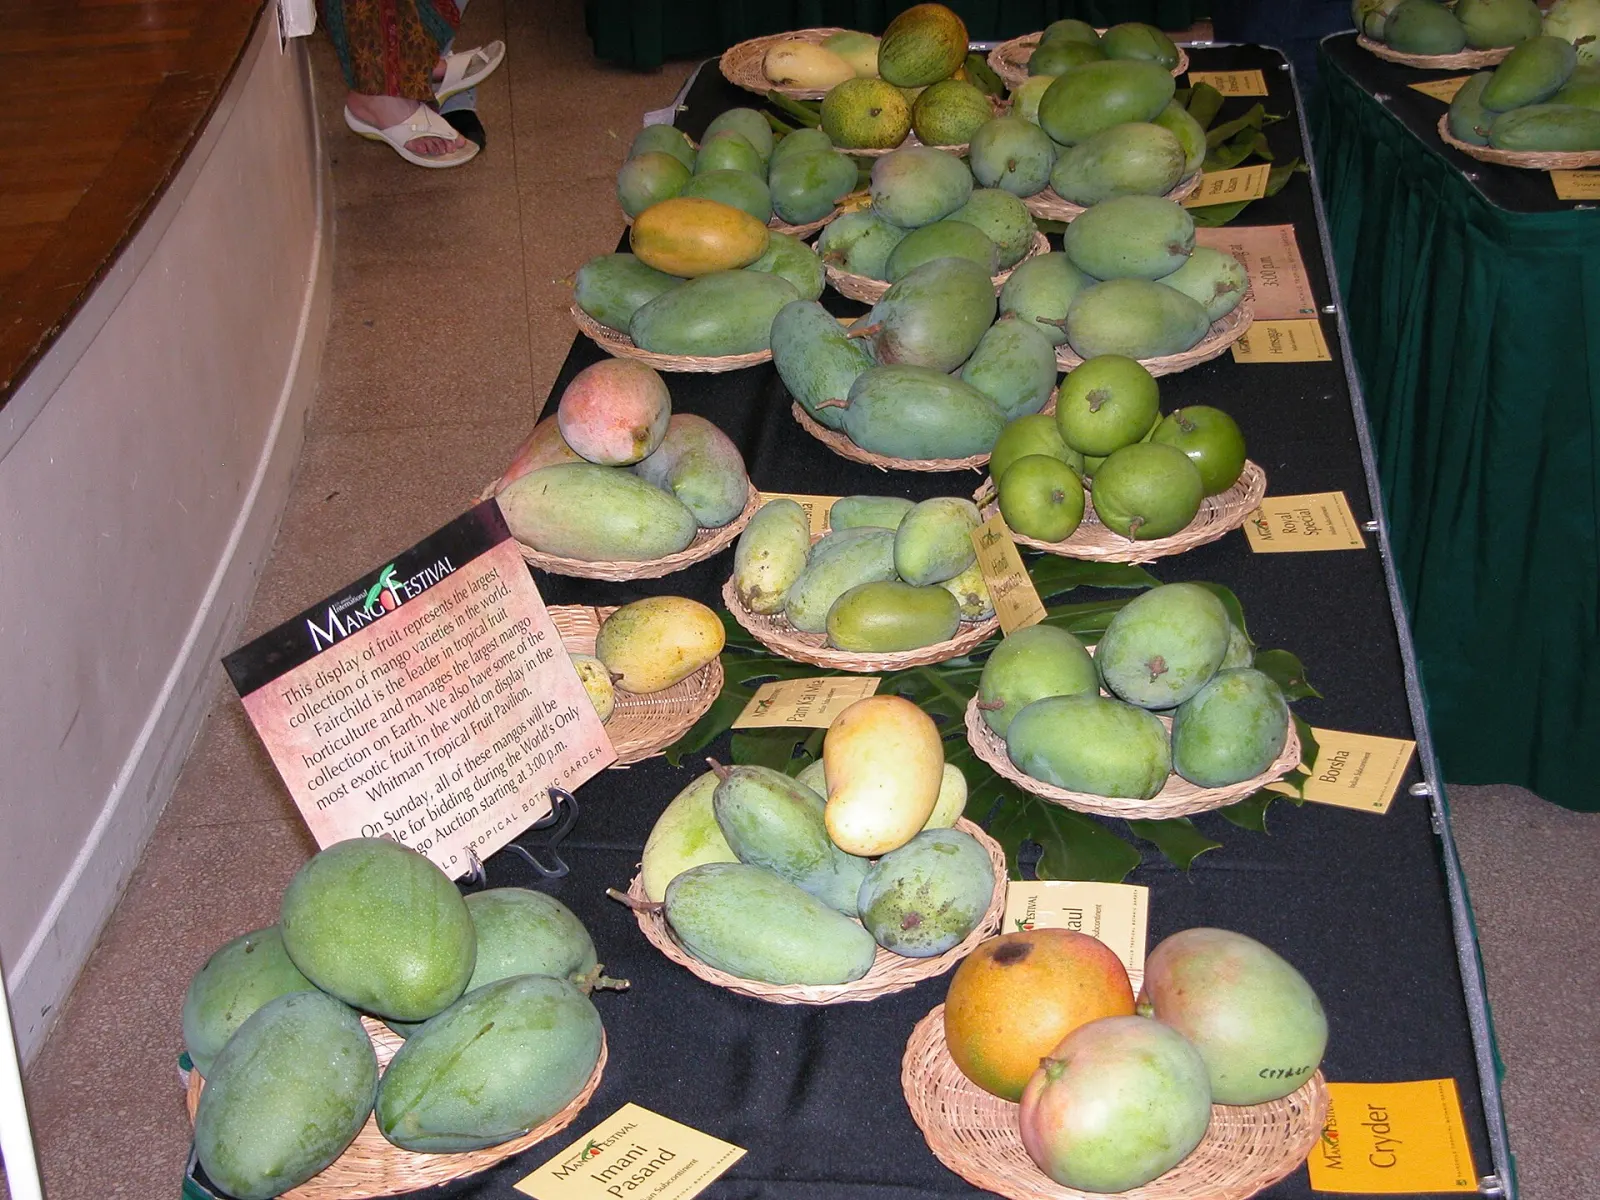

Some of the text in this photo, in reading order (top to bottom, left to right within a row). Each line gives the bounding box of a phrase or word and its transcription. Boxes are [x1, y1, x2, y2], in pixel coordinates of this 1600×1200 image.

[1274, 512, 1298, 534] Royal
[1293, 508, 1322, 536] Special
[282, 566, 500, 706] This display of fruit represents the largest
[289, 581, 512, 728] collection of mango varieties in the world.
[314, 607, 509, 738] Fairchild is the leader in tropical fruit
[302, 616, 531, 769] horticulture and manages the largest mango
[307, 630, 546, 791] collection on Earth. We also have some of the
[316, 647, 555, 811] most exotic fruit in the world on display in the
[361, 821, 384, 838] On
[384, 790, 434, 826] Sunday,
[434, 773, 451, 794] all
[451, 763, 465, 782] of
[464, 749, 492, 773] these
[492, 722, 527, 754] mangos
[526, 708, 545, 726] will
[544, 699, 558, 713] be
[365, 686, 533, 802] Whitman Tropical Fruit Pavilion.
[408, 705, 581, 835] for bidding during the World's Only
[563, 746, 602, 779] GARDEN
[1319, 750, 1350, 783] Borsha
[435, 806, 479, 843] Auction
[479, 778, 519, 811] starting
[518, 771, 528, 785] at
[525, 752, 548, 776] 3:00
[547, 740, 568, 764] p.m.
[1025, 895, 1038, 925] FESTIVAL
[551, 1122, 639, 1181] MANGO FESTIVAL
[590, 1143, 649, 1184] Imani
[606, 1147, 677, 1199] Pasand
[654, 1158, 698, 1192] Subcontinent
[1361, 1104, 1403, 1168] Cryder
